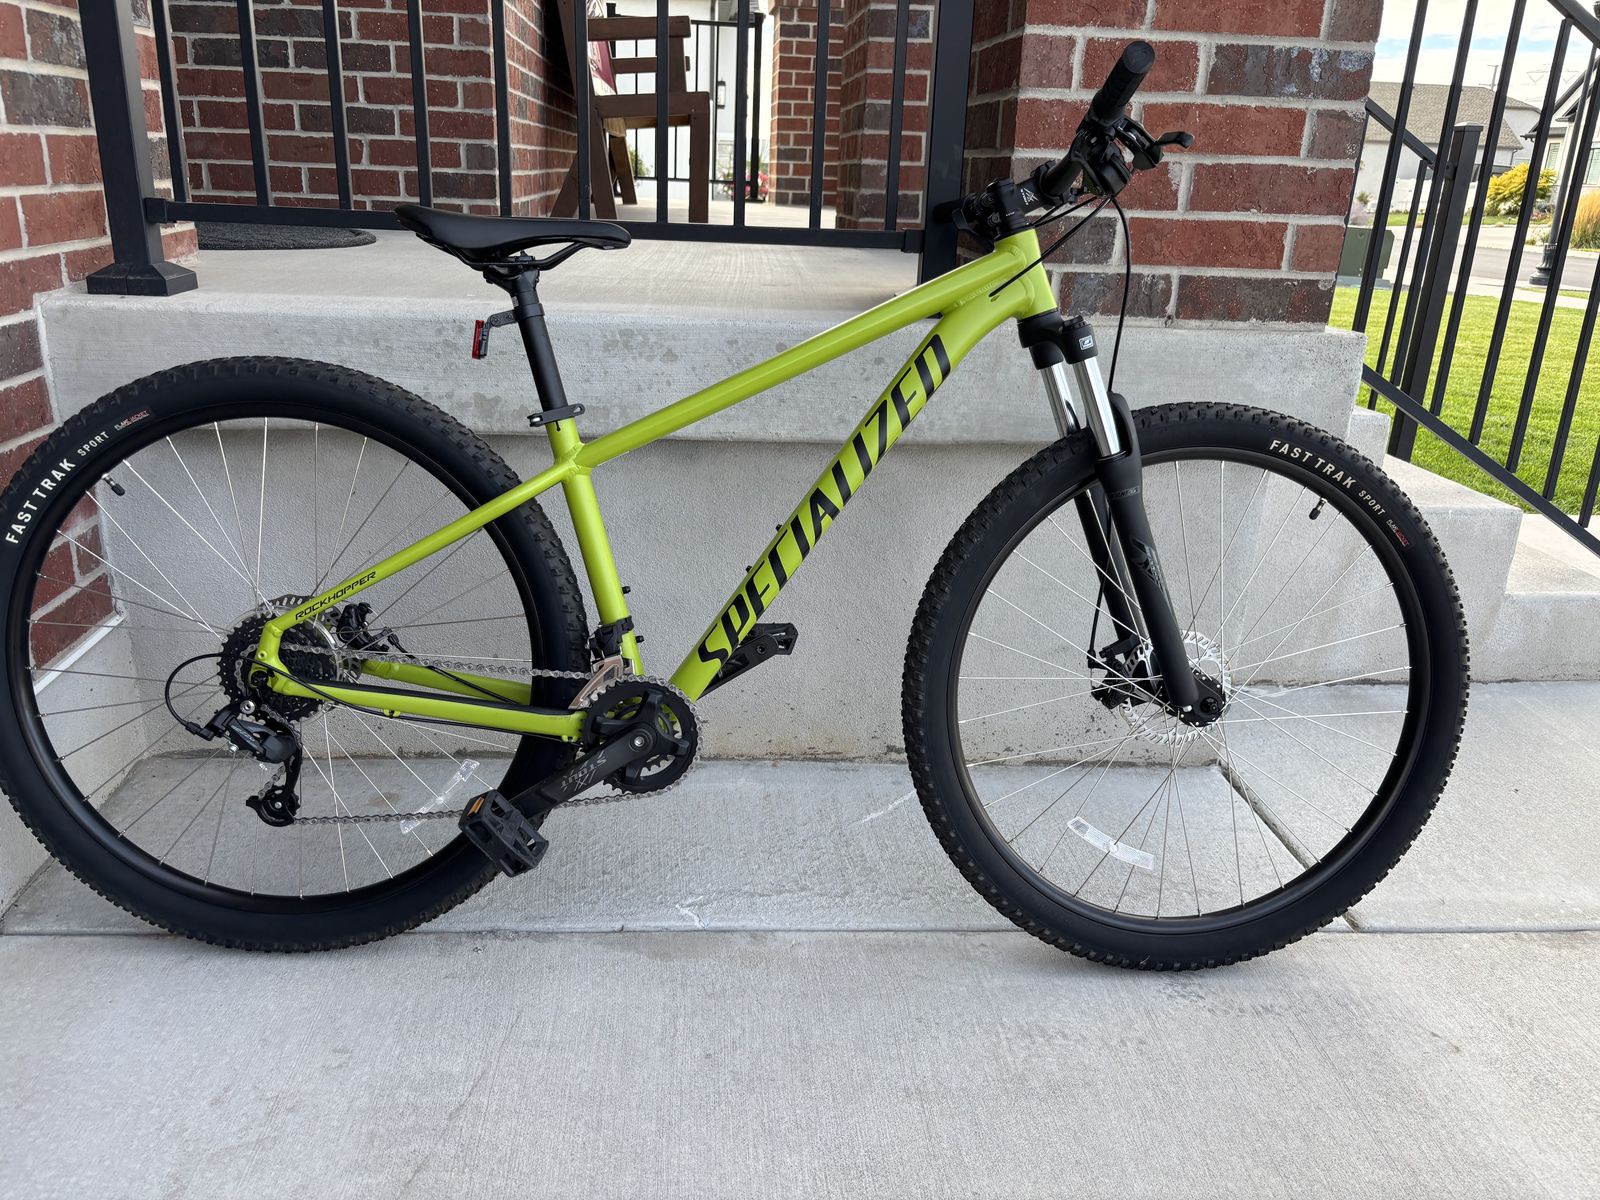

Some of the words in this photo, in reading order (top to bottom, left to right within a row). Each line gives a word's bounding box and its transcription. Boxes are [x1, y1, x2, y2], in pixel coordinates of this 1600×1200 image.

[5, 500, 38, 544] FAST
[32, 458, 76, 499] TRAK
[77, 431, 109, 456] SPORT
[698, 333, 951, 667] SPECIALIZED
[1269, 439, 1313, 463] FAST
[1314, 457, 1357, 489] TRAK
[1358, 489, 1386, 516] SPORT
[295, 571, 376, 620] ROCKHOPPER
